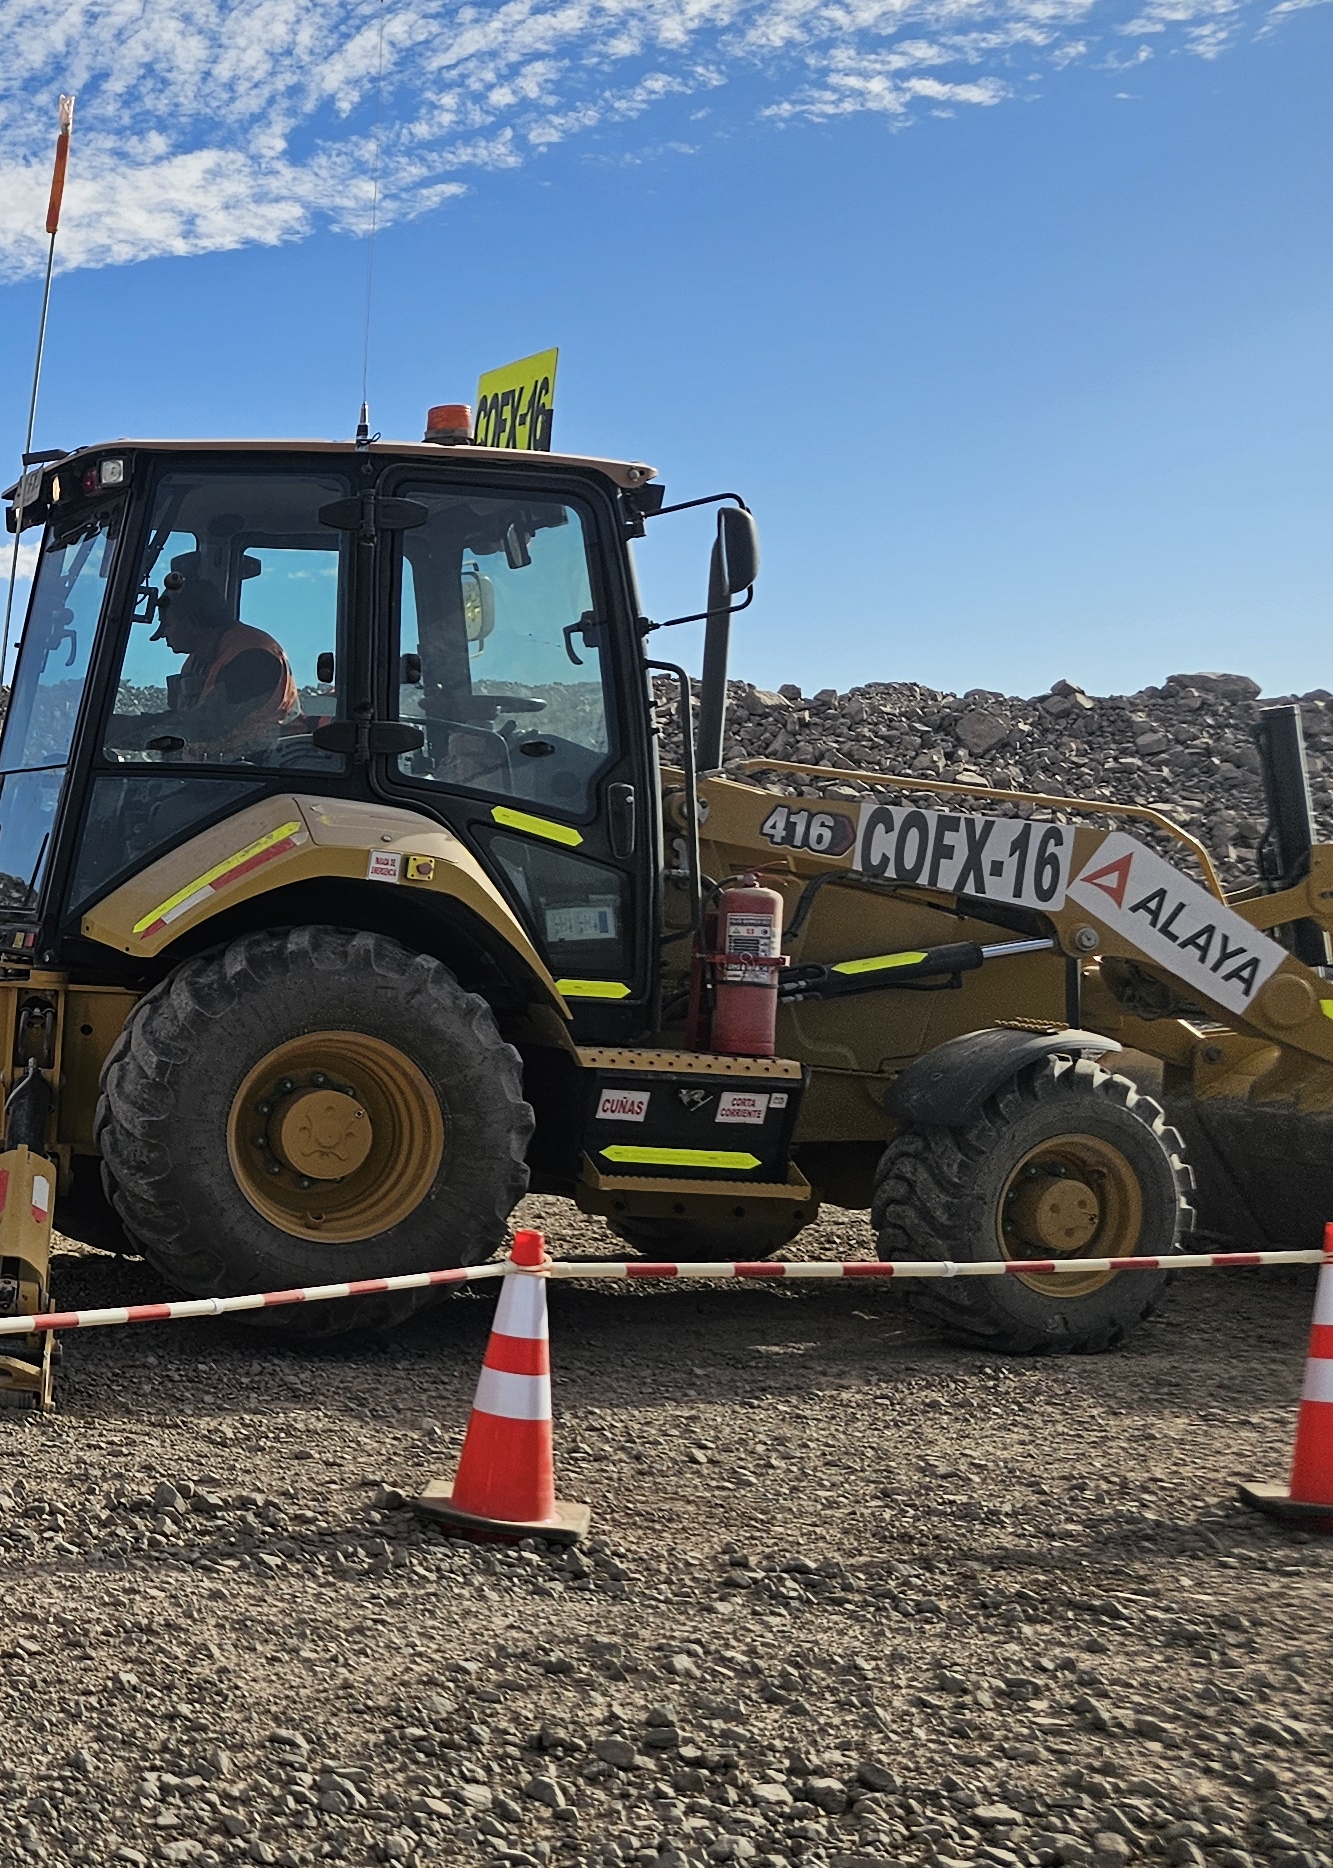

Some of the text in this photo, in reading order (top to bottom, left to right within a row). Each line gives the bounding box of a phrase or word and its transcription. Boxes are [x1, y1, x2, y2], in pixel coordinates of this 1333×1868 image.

[474, 376, 551, 451] COFX-16
[761, 806, 835, 851] 416
[860, 805, 1064, 903] COFX-16
[1127, 887, 1262, 998] ALAYA
[601, 1096, 645, 1116] CUÑAS
[720, 1107, 762, 1118] CORRIENTE
[732, 1097, 755, 1107] CORTA
